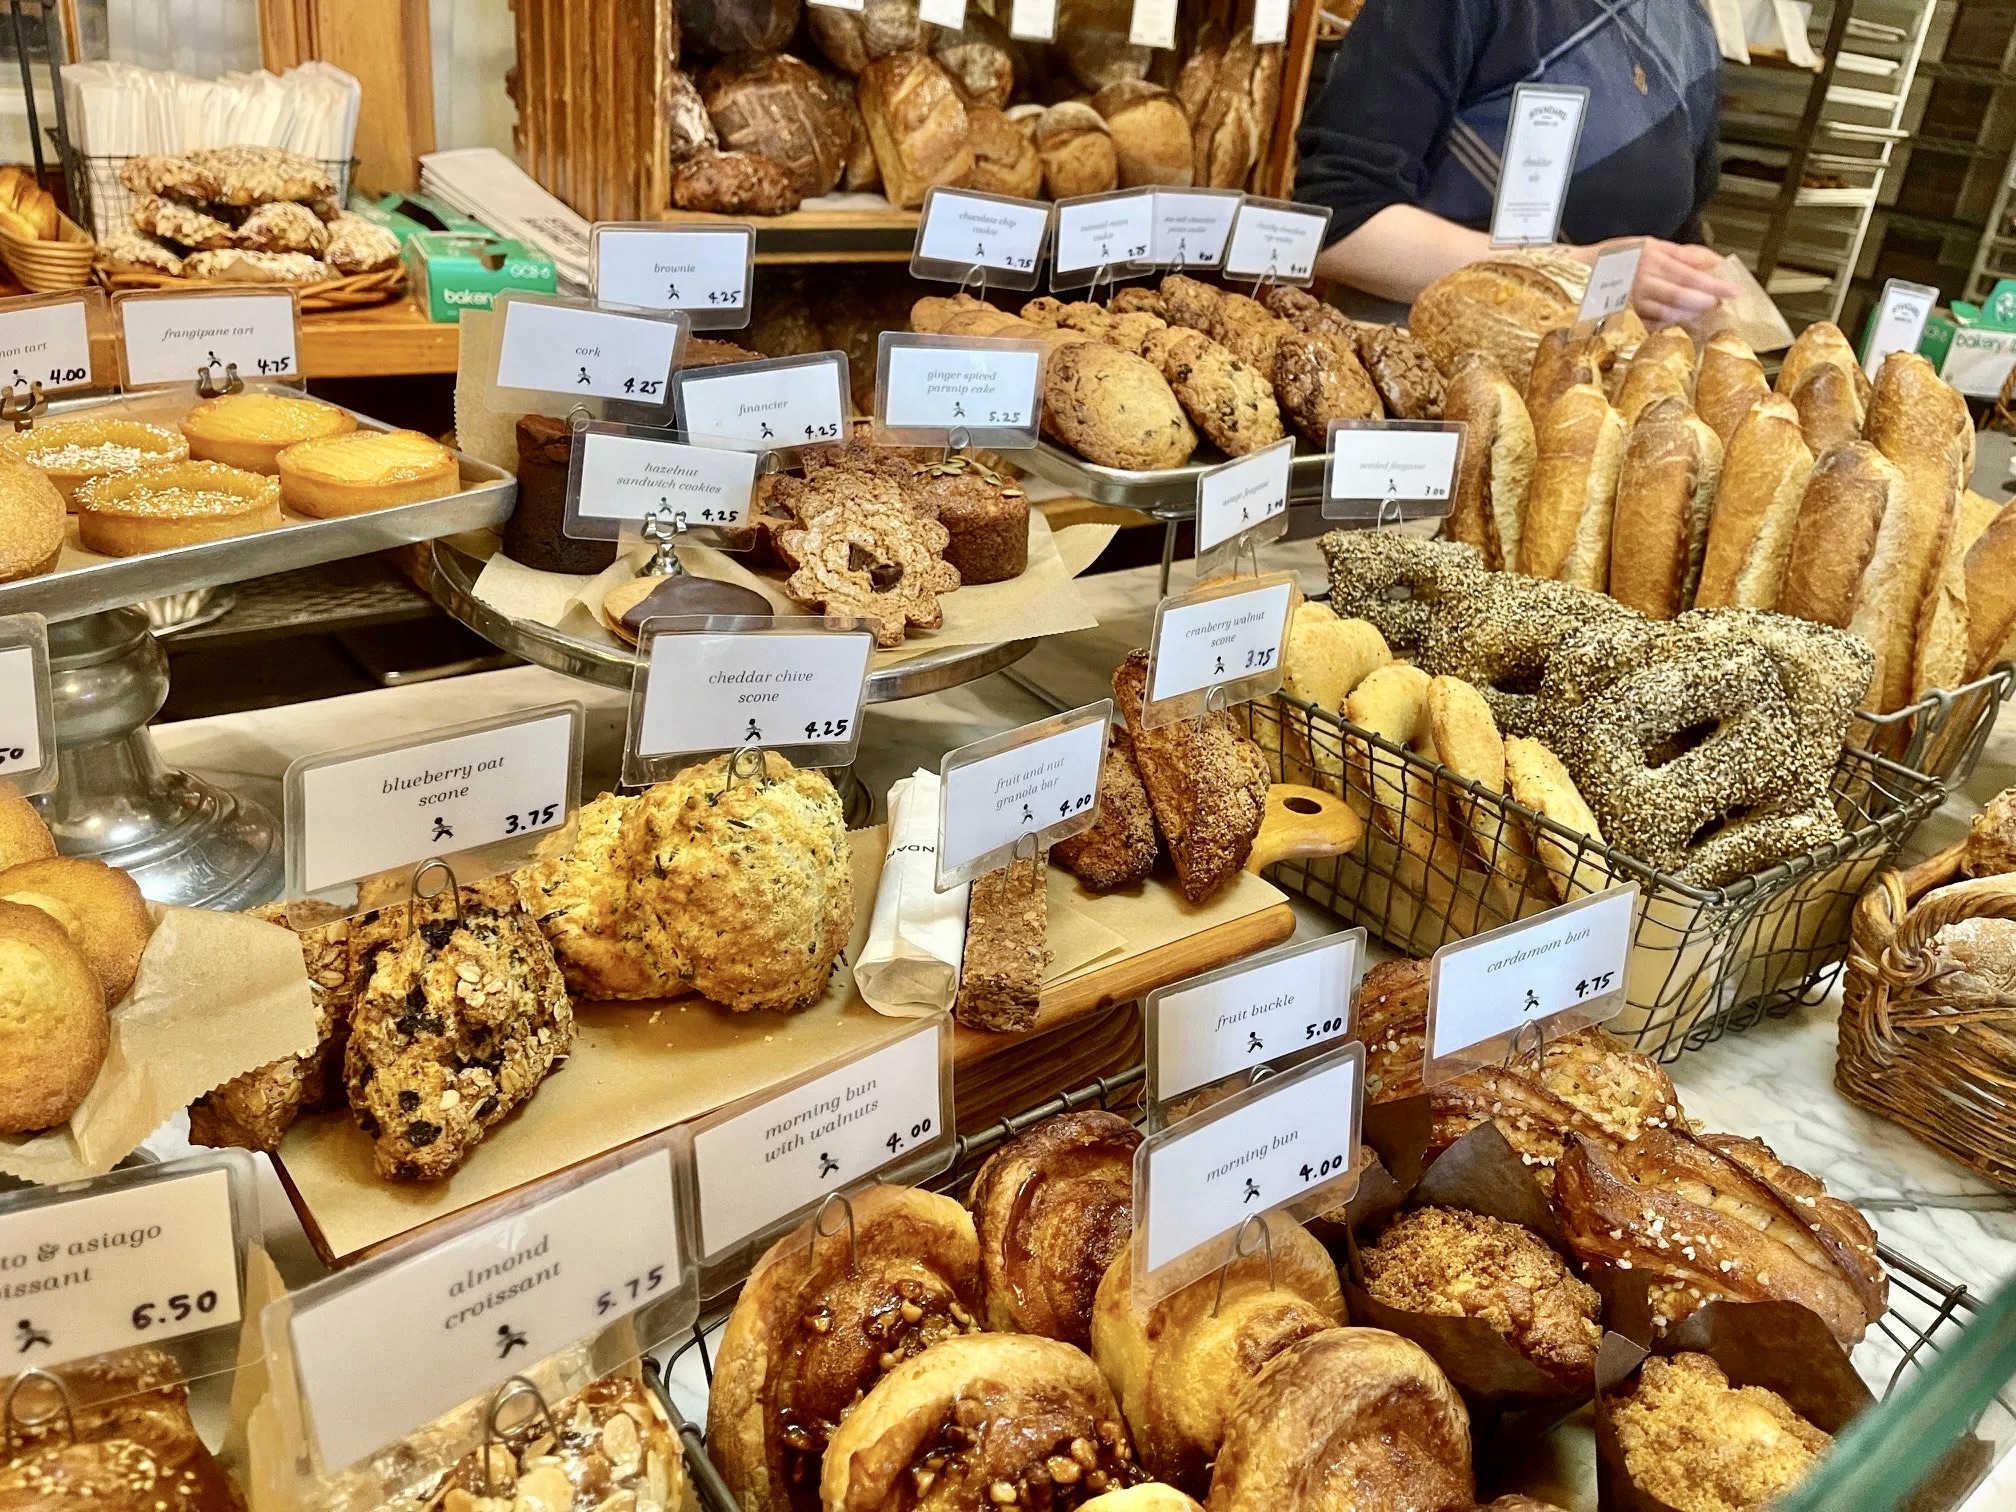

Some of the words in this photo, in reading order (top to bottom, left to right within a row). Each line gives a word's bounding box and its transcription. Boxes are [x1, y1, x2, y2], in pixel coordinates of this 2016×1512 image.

[653, 262, 696, 274] brownie
[1005, 256, 1033, 268] 2.75
[444, 288, 492, 305] baker
[708, 290, 741, 304] 4.25
[162, 328, 230, 342] frangipane
[233, 325, 254, 336] tart
[25, 341, 48, 354] tart
[575, 346, 601, 357] cork
[50, 368, 86, 385] 4.00
[258, 357, 290, 375] 4.75
[927, 370, 962, 382] ginger
[964, 371, 997, 382] spiced
[624, 377, 664, 395] 4.25
[927, 384, 968, 395] parsnip
[971, 384, 995, 394] cake
[737, 399, 789, 417] financier
[989, 411, 1021, 423] 5.25
[804, 423, 838, 440] 4.25
[644, 462, 700, 477] hazelnut
[616, 475, 676, 490] sandwich
[678, 482, 722, 494] cookies
[701, 508, 739, 522] 4.25
[1185, 620, 1232, 638] cranberry
[1234, 610, 1266, 627] walnut
[1211, 633, 1236, 647] scone
[1245, 647, 1276, 668] 3.75
[708, 670, 773, 685] cheddar
[775, 669, 814, 683] chive
[738, 691, 780, 704] scone
[804, 719, 849, 739] 4.25
[382, 768, 473, 795] blueberry
[477, 756, 506, 773] oat
[995, 773, 1021, 794] fruit
[1023, 762, 1045, 782] and
[1046, 757, 1065, 774] nut
[418, 785, 470, 807] scone
[996, 786, 1039, 811] granola
[1041, 775, 1060, 794] bar
[1059, 793, 1092, 817] 4.00
[505, 803, 559, 834] 3.75
[1486, 939, 1561, 974] cardamom
[1564, 927, 1591, 945] bun
[1575, 971, 1615, 998] 4.75
[1214, 1010, 1248, 1032] fruit
[1251, 994, 1295, 1017] buckle
[1305, 1017, 1342, 1040] 5.00
[765, 1095, 841, 1141] morning
[845, 1079, 877, 1102] bun
[764, 1134, 805, 1163] with
[810, 1099, 879, 1141] walnuts
[886, 1118, 932, 1154] 4.00
[1206, 1144, 1268, 1183] morning
[1272, 1130, 1299, 1149] bun
[1299, 1154, 1343, 1182] 4.00
[37, 1243, 60, 1263] &
[67, 1225, 162, 1257] asiago
[448, 1234, 551, 1298] almond
[0, 1266, 94, 1300] issant
[596, 1264, 665, 1317] 5.75
[444, 1260, 562, 1331] croissant
[132, 1289, 218, 1331] 6.50
